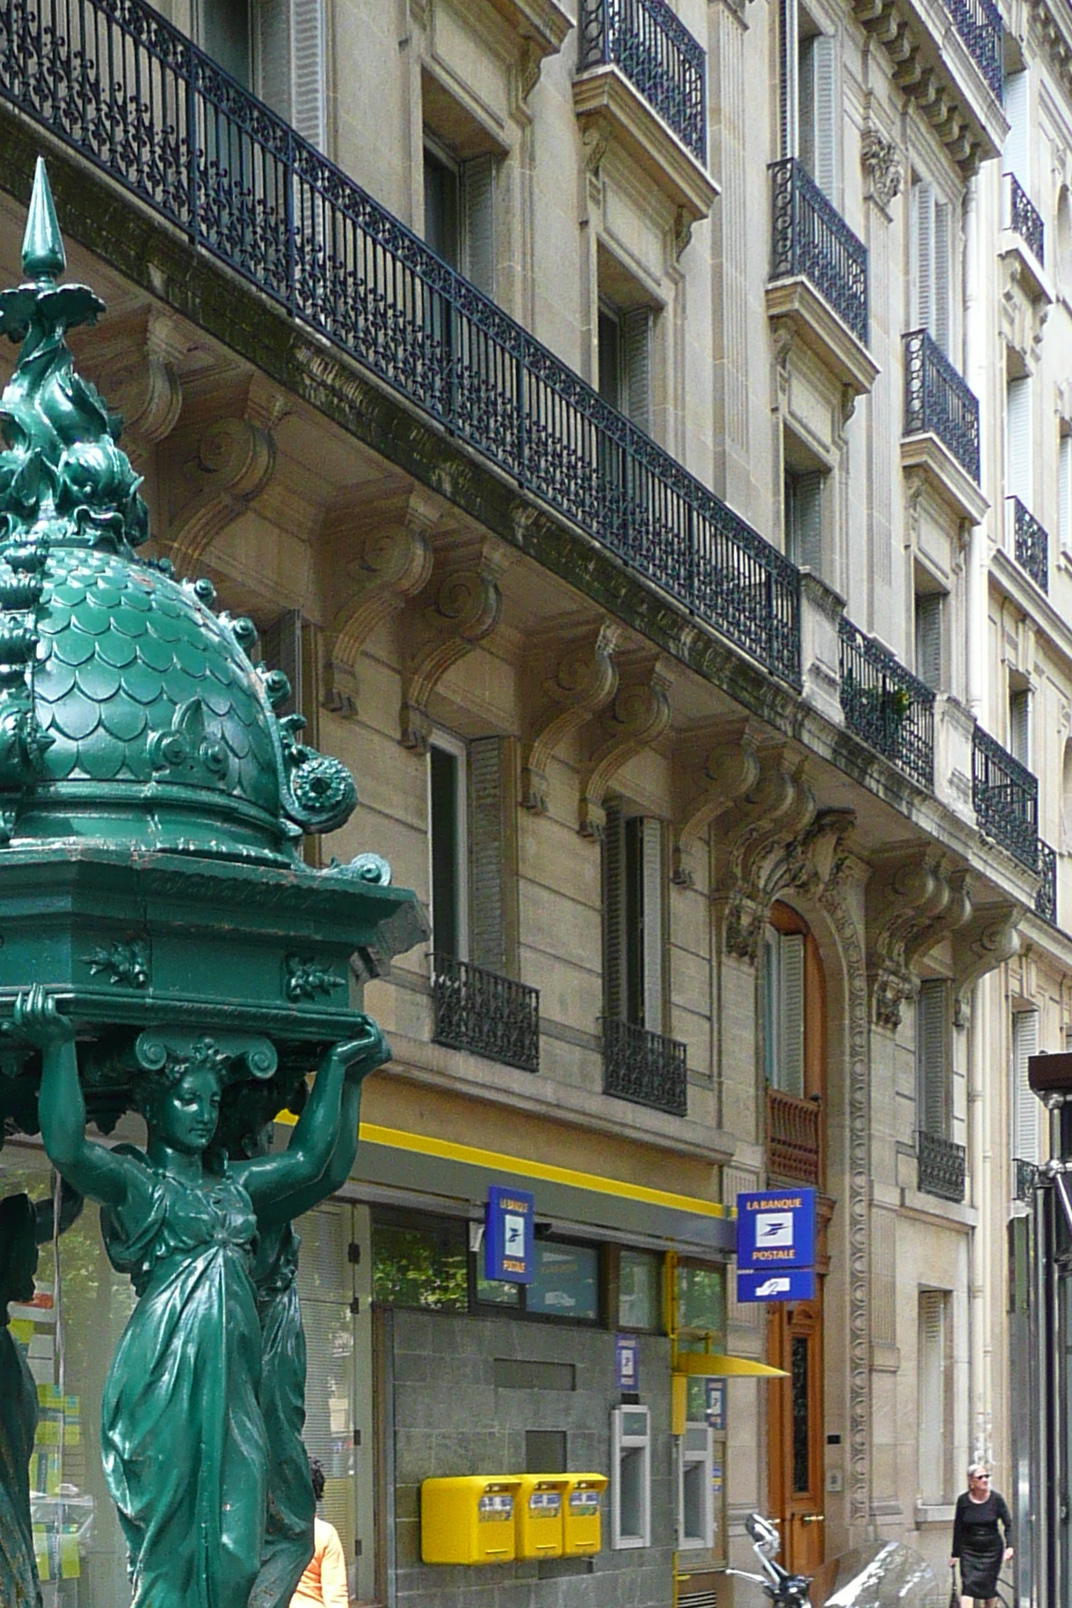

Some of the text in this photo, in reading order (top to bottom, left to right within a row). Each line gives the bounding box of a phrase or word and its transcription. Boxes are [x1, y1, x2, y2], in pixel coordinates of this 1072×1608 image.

[746, 1198, 803, 1210] LA BANQUE
[752, 1250, 796, 1260] POSTALE
